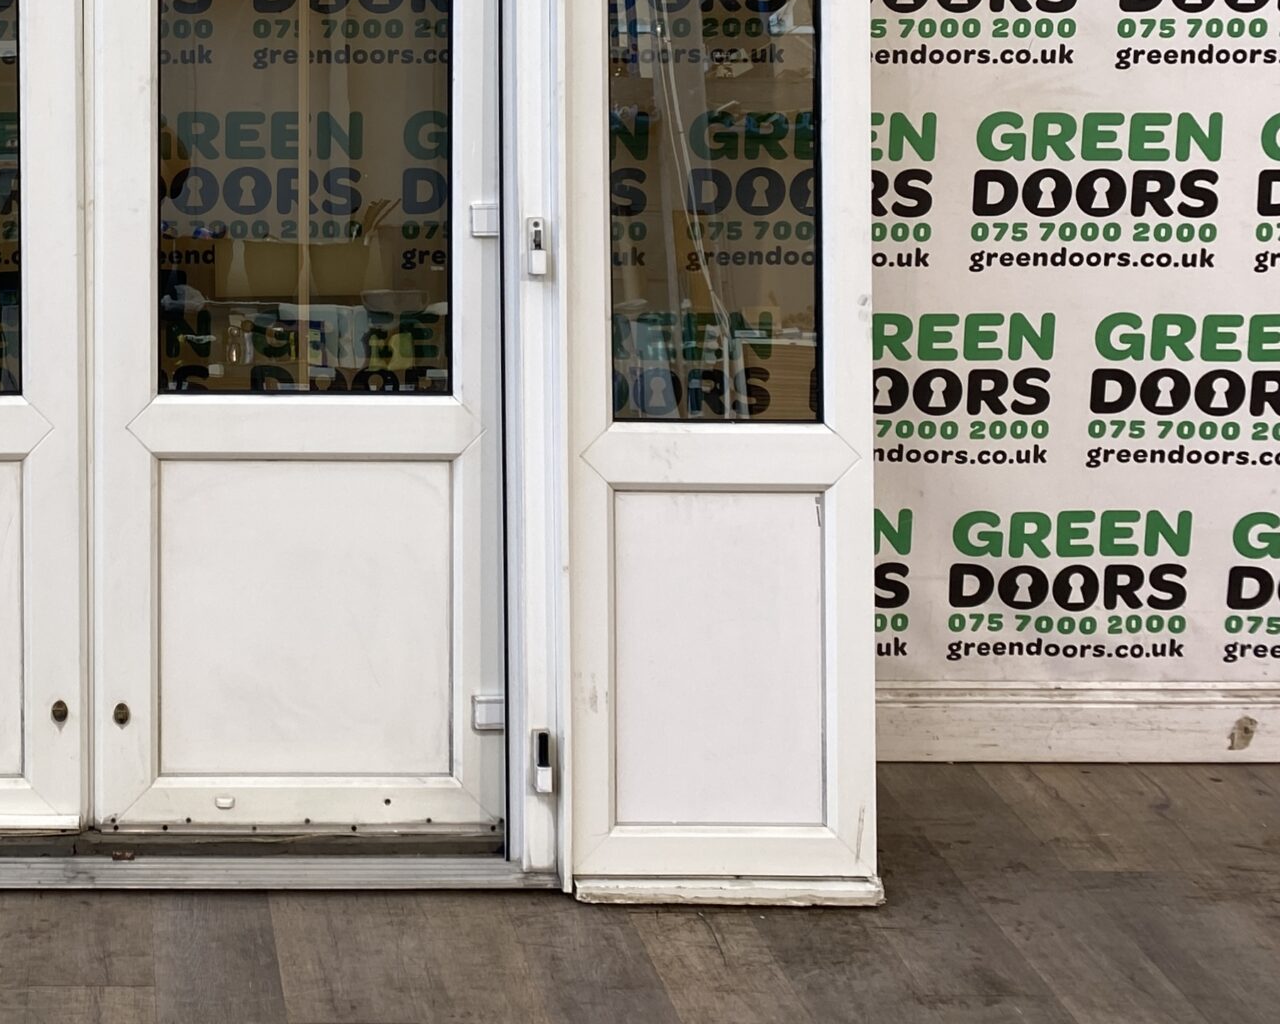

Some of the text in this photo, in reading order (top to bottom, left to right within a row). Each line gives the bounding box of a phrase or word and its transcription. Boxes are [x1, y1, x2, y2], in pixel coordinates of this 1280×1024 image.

[898, 18, 1076, 38] 7000 2000
[1117, 18, 1268, 38] 075 7000
[176, 111, 363, 160] REEN
[976, 111, 1223, 162] GREEN
[972, 169, 1218, 218] DOORS
[971, 222, 1217, 242] 075 7000 2000
[969, 247, 1214, 272] greendoors.co.uk
[872, 313, 1055, 361] REEN
[1095, 312, 1280, 362] GREE
[876, 420, 1049, 440] 7000 2000
[1088, 420, 1240, 440] 075 7000
[952, 510, 1192, 558] GREEN
[949, 563, 1186, 612] DOORS
[948, 613, 1186, 635] 075 7000 2000
[1225, 615, 1280, 635] 075
[946, 638, 1183, 661] greendoors.co.uk
